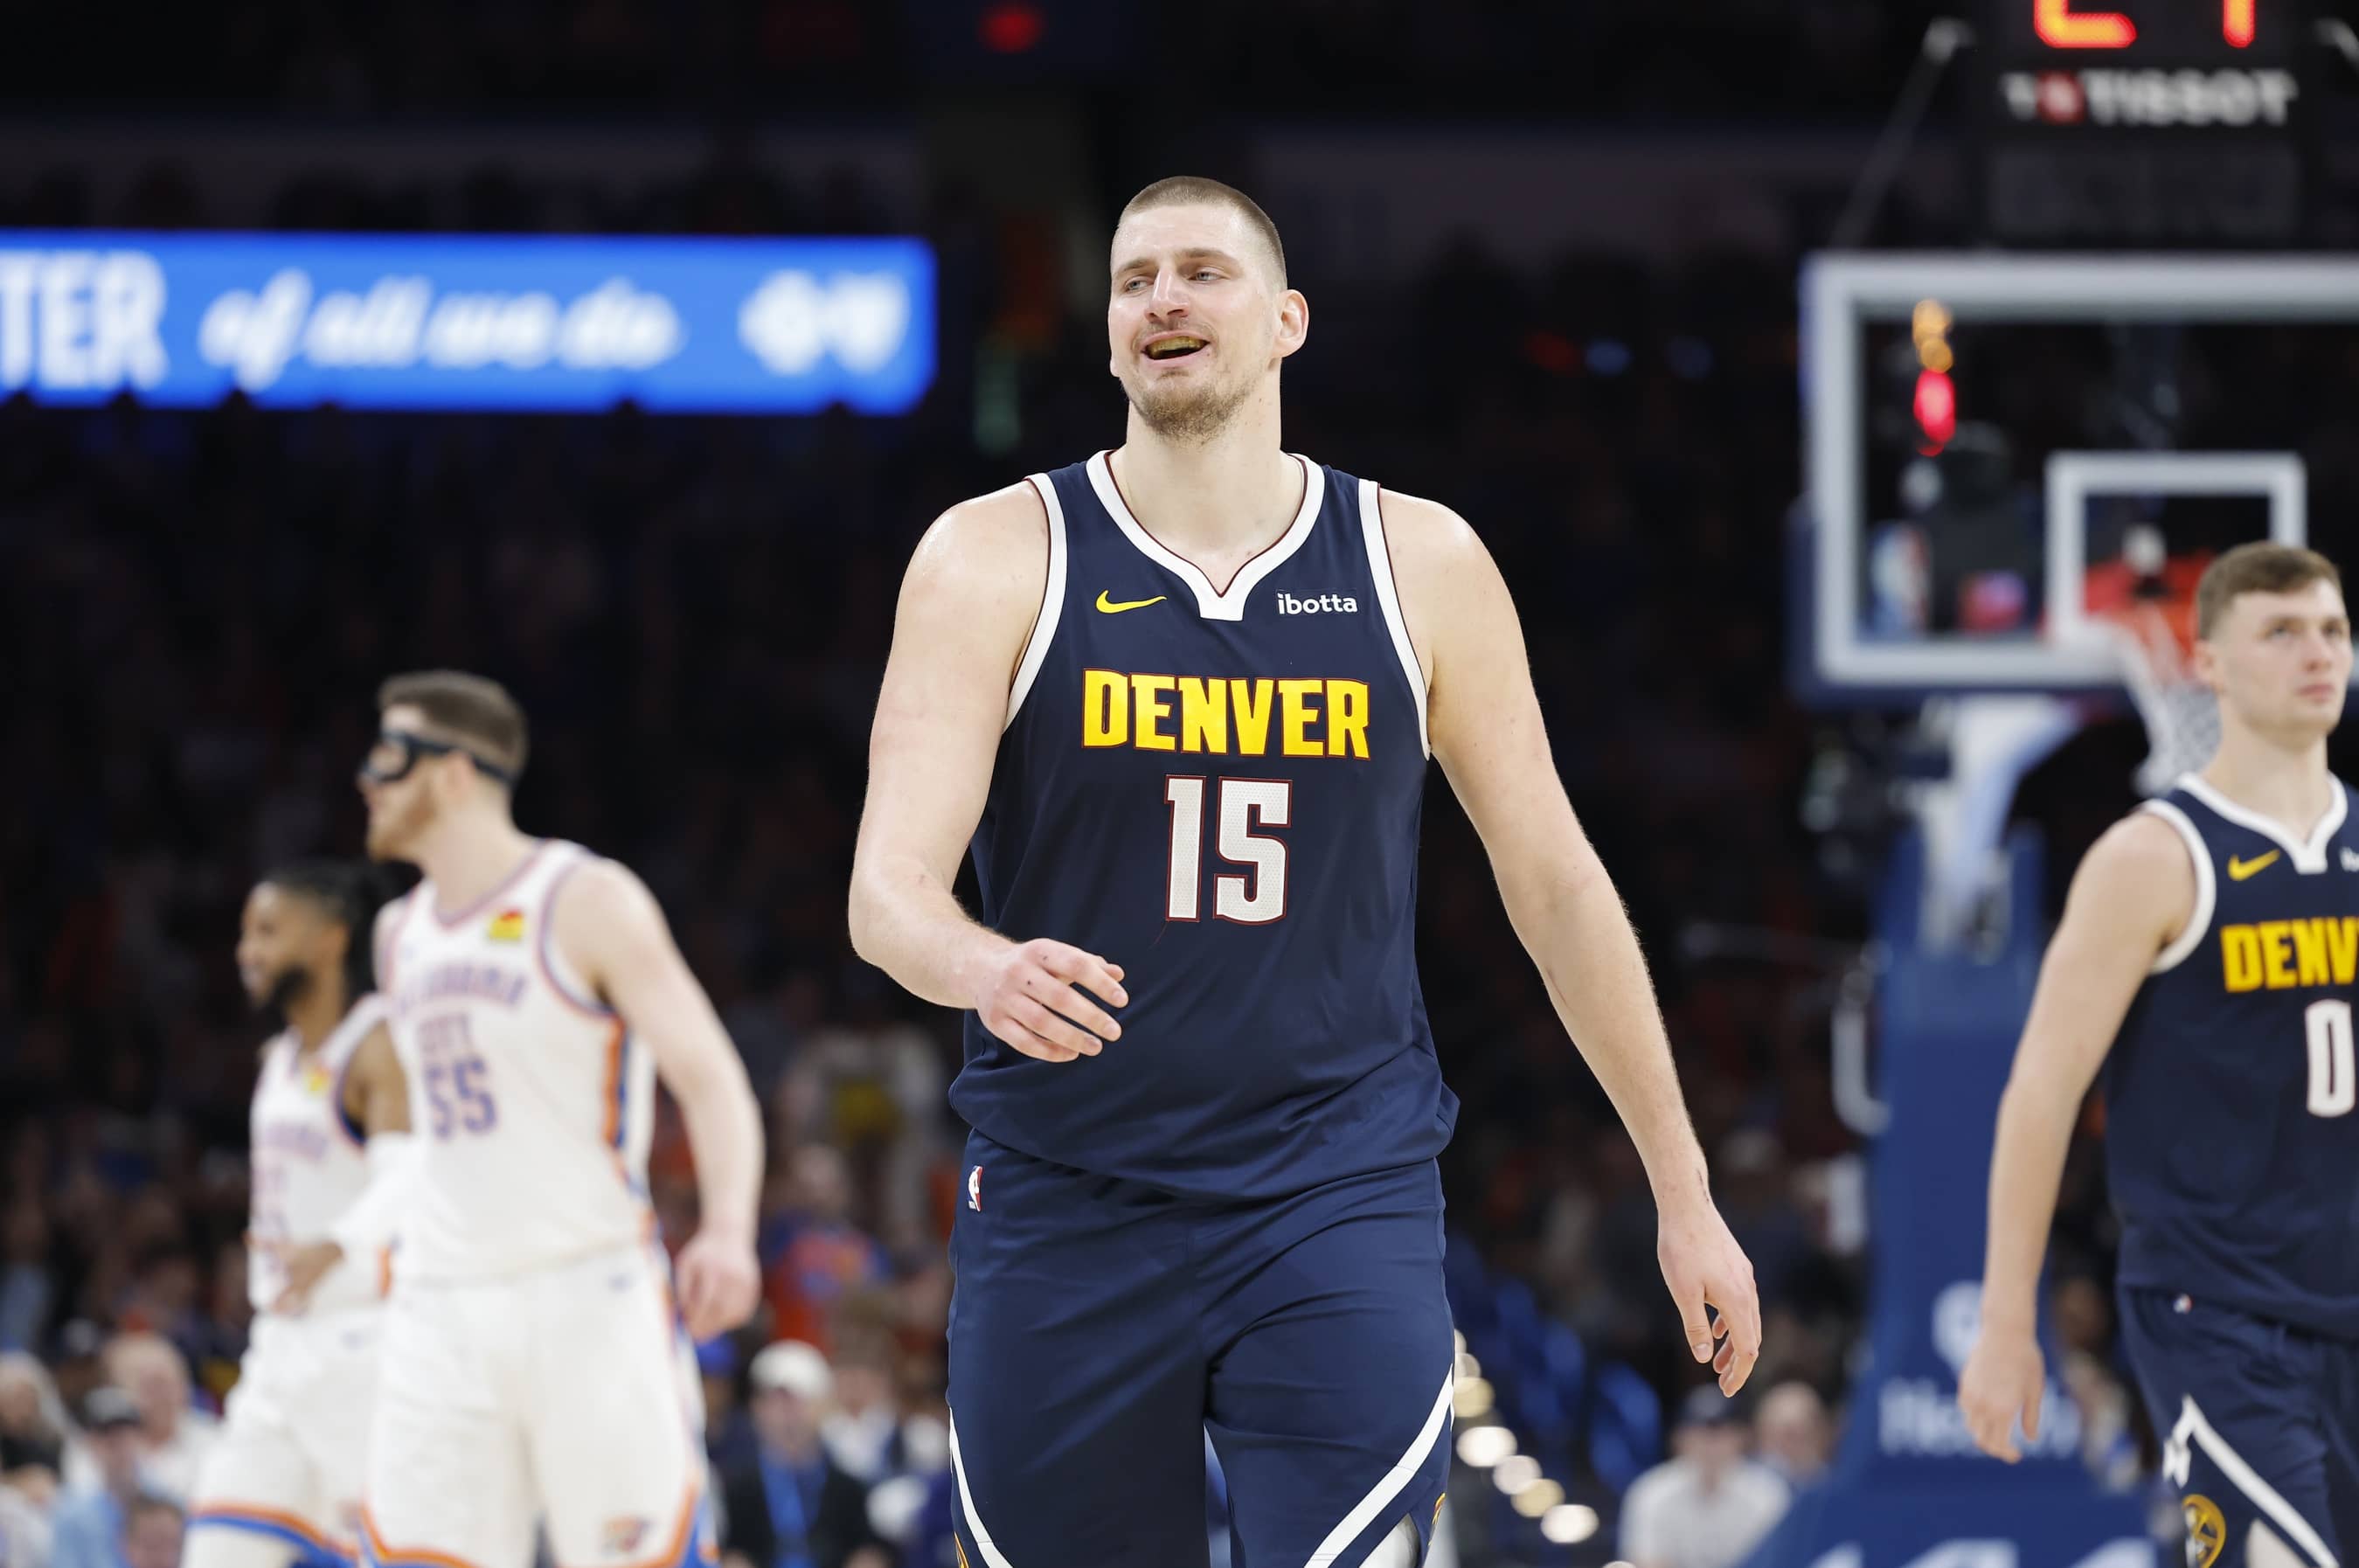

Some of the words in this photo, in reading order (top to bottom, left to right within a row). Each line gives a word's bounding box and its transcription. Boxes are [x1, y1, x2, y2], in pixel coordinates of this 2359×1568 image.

[1276, 592, 1359, 615] ibotta
[1081, 668, 1371, 760] DENVER
[1164, 774, 1293, 926] 15
[2219, 915, 2359, 993] DENV
[421, 1053, 500, 1141] 55
